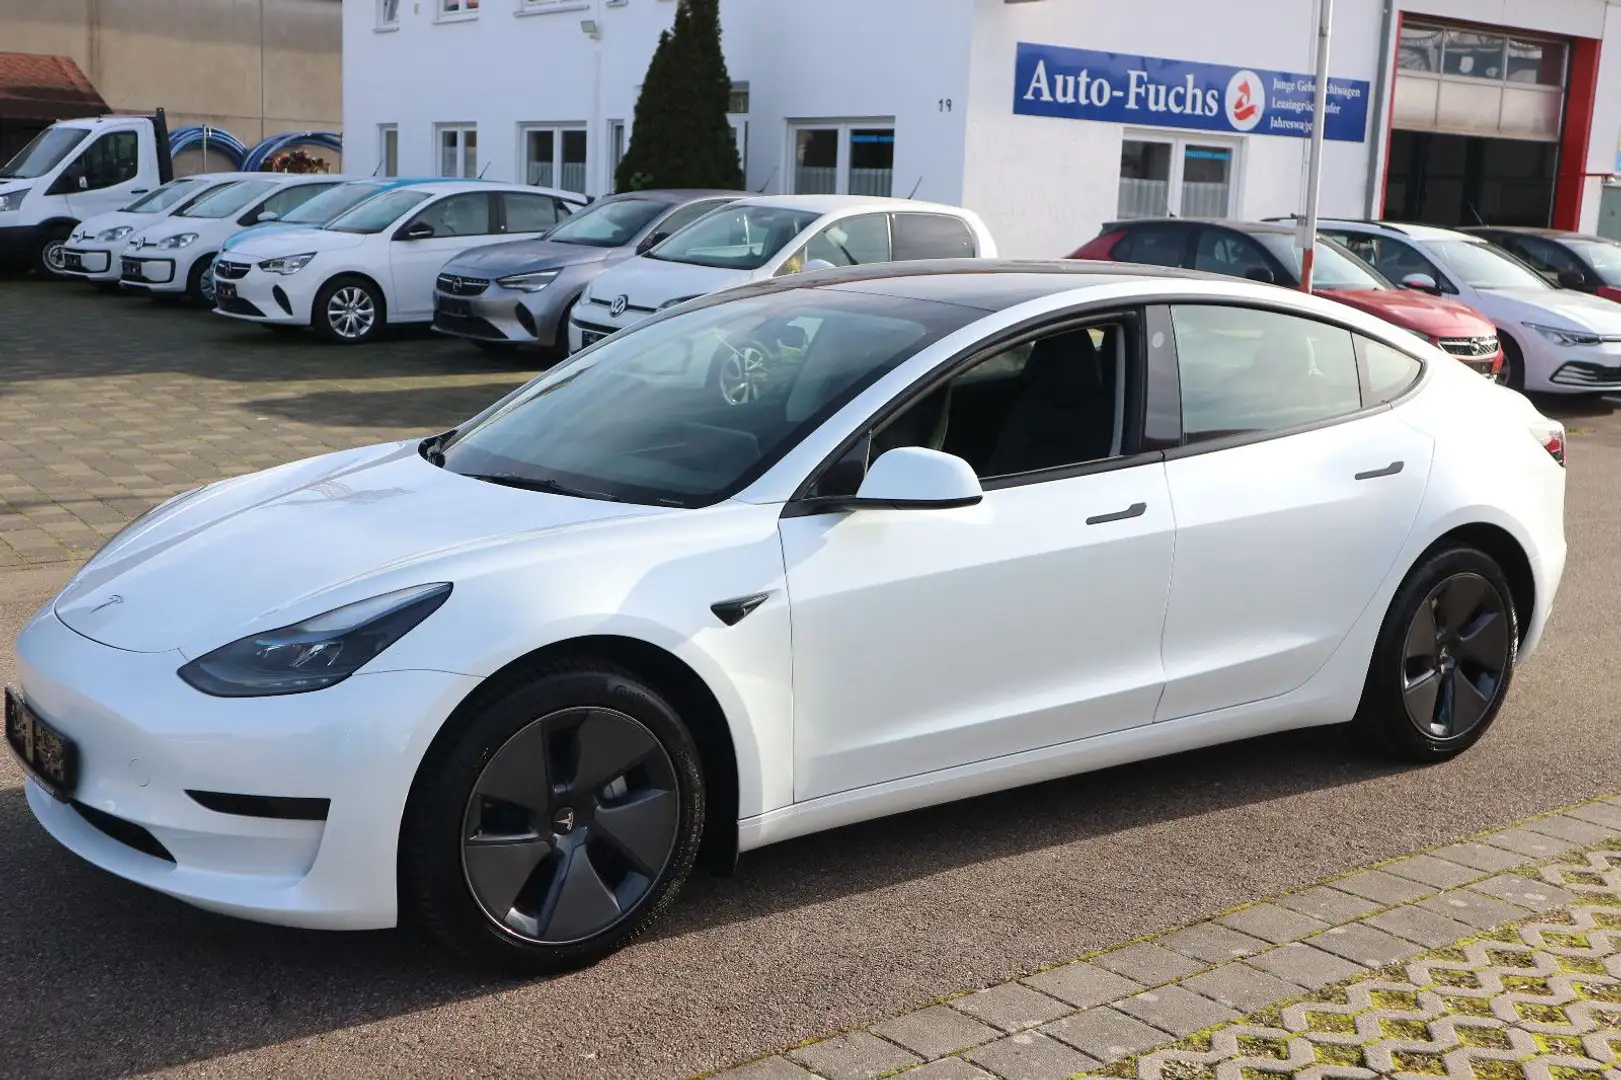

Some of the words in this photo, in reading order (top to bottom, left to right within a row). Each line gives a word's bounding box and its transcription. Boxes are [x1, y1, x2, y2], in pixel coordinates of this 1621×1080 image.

[1023, 59, 1219, 116] Auto-Fuchs
[1272, 78, 1296, 93] Junge
[938, 98, 952, 112] 19
[1270, 116, 1314, 133] Jahreswage
